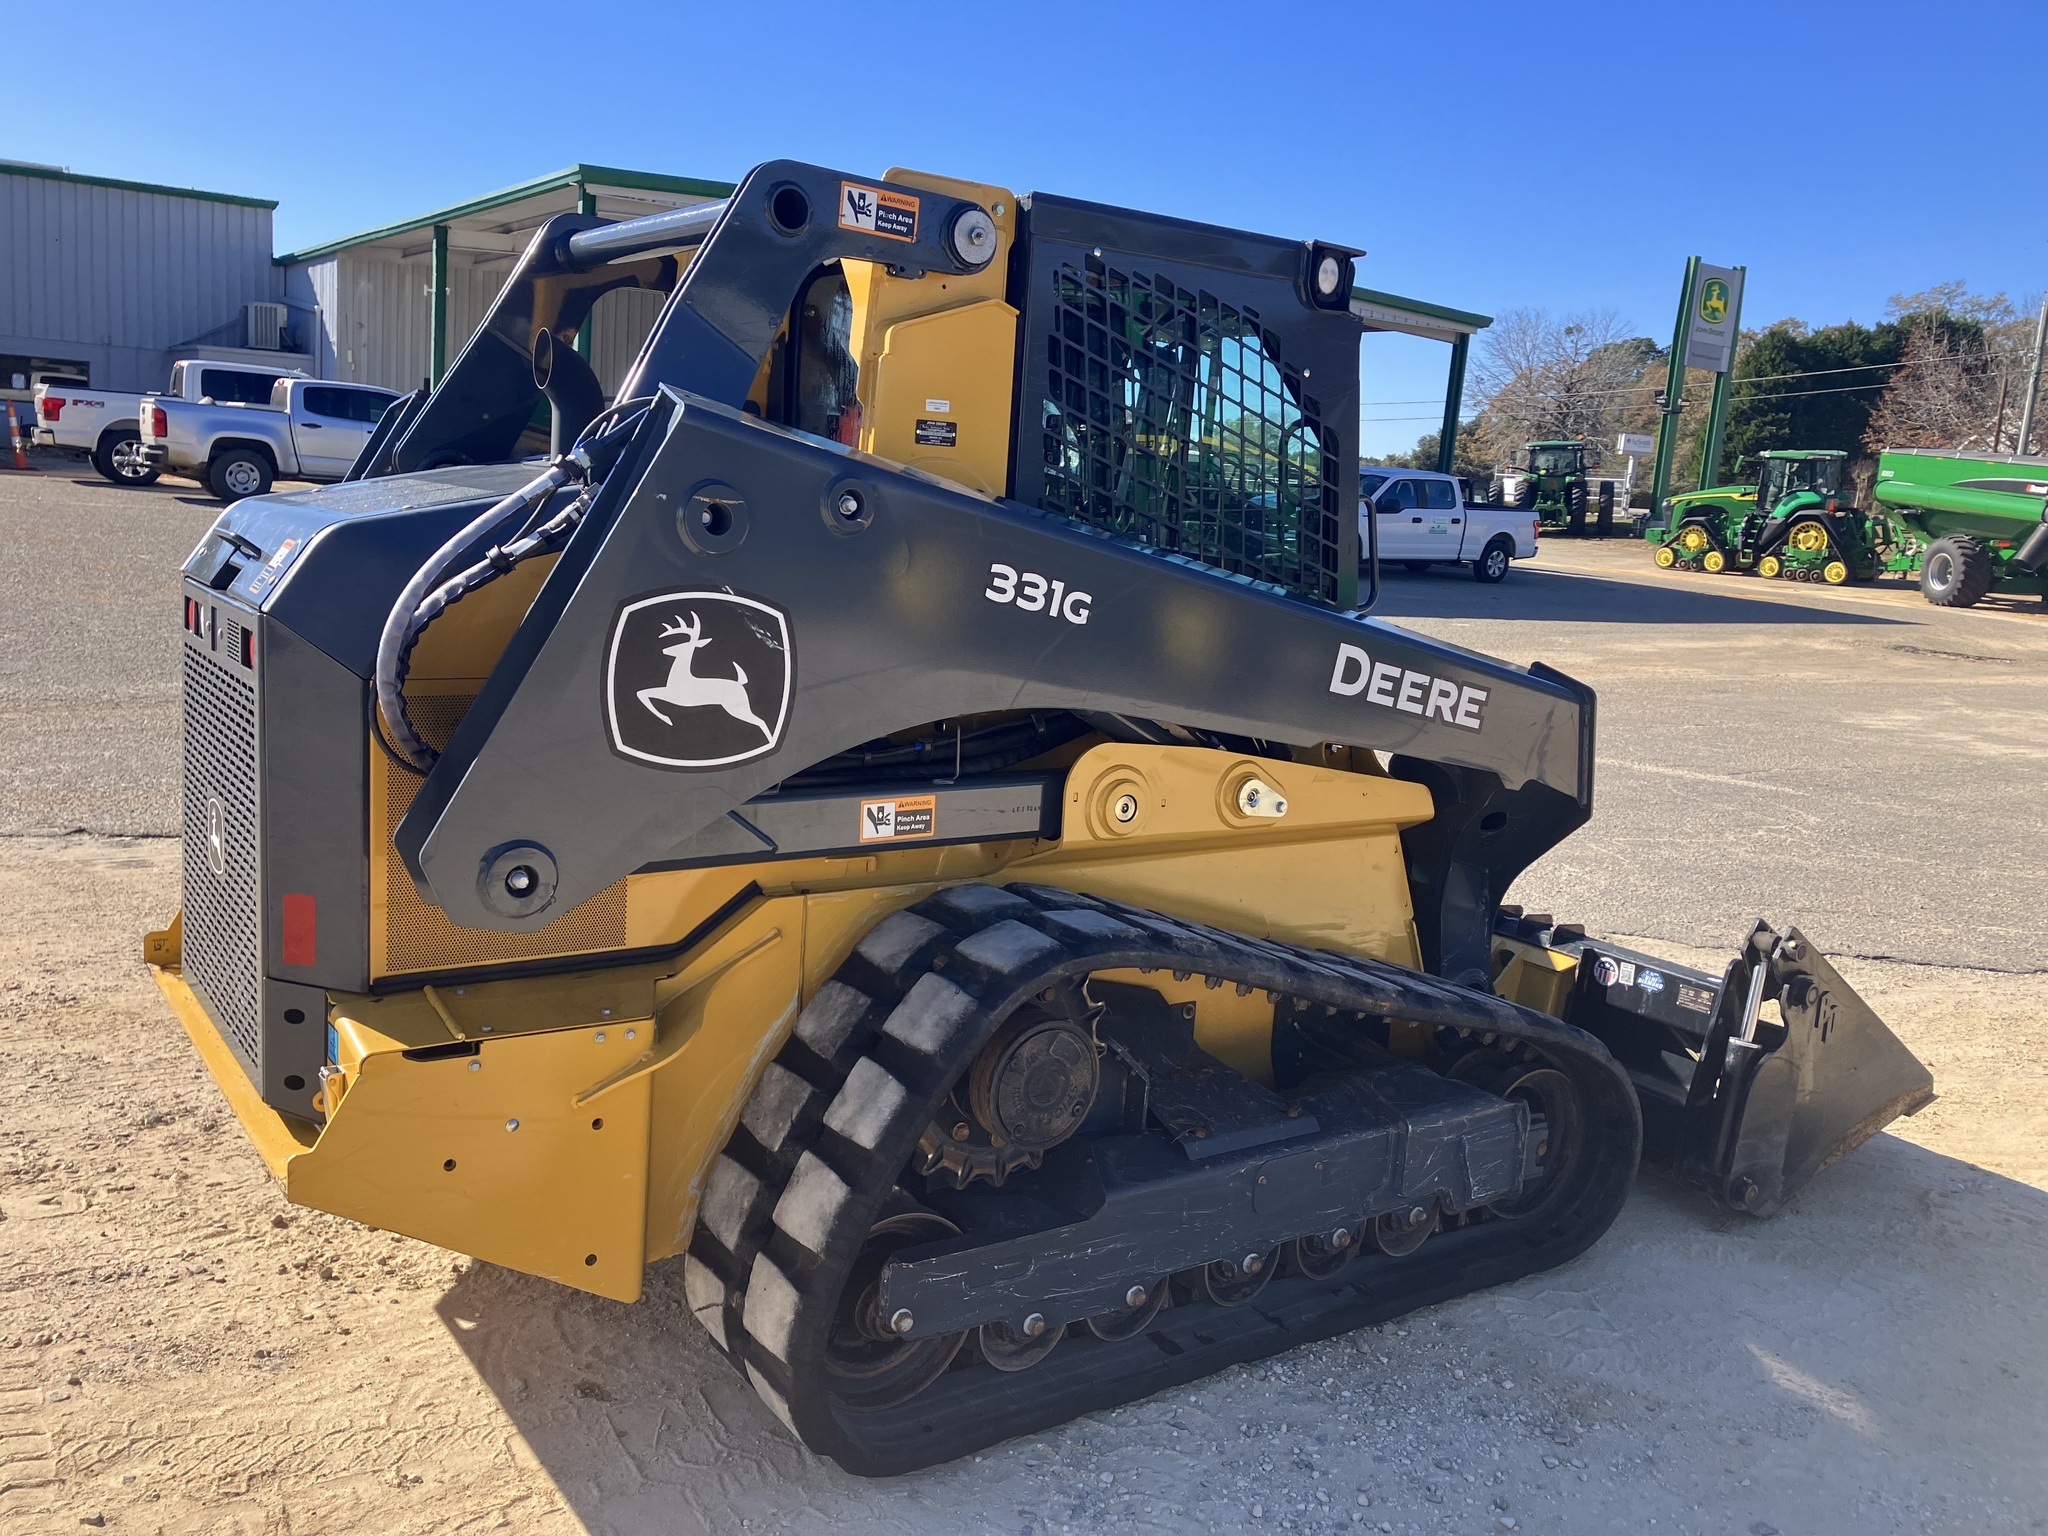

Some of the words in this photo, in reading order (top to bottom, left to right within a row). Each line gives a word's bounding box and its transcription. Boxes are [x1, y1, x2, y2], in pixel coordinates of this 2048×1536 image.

[887, 196, 915, 208] WARNING
[897, 214, 913, 224] Area
[877, 220, 892, 229] Keep
[892, 223, 908, 233] Away
[1695, 325, 1708, 333] JOHN
[1708, 327, 1726, 337] DEERE
[72, 399, 105, 408] FX4
[985, 563, 1092, 625] 331G
[1329, 642, 1488, 729] DEERE
[915, 814, 930, 822] Area
